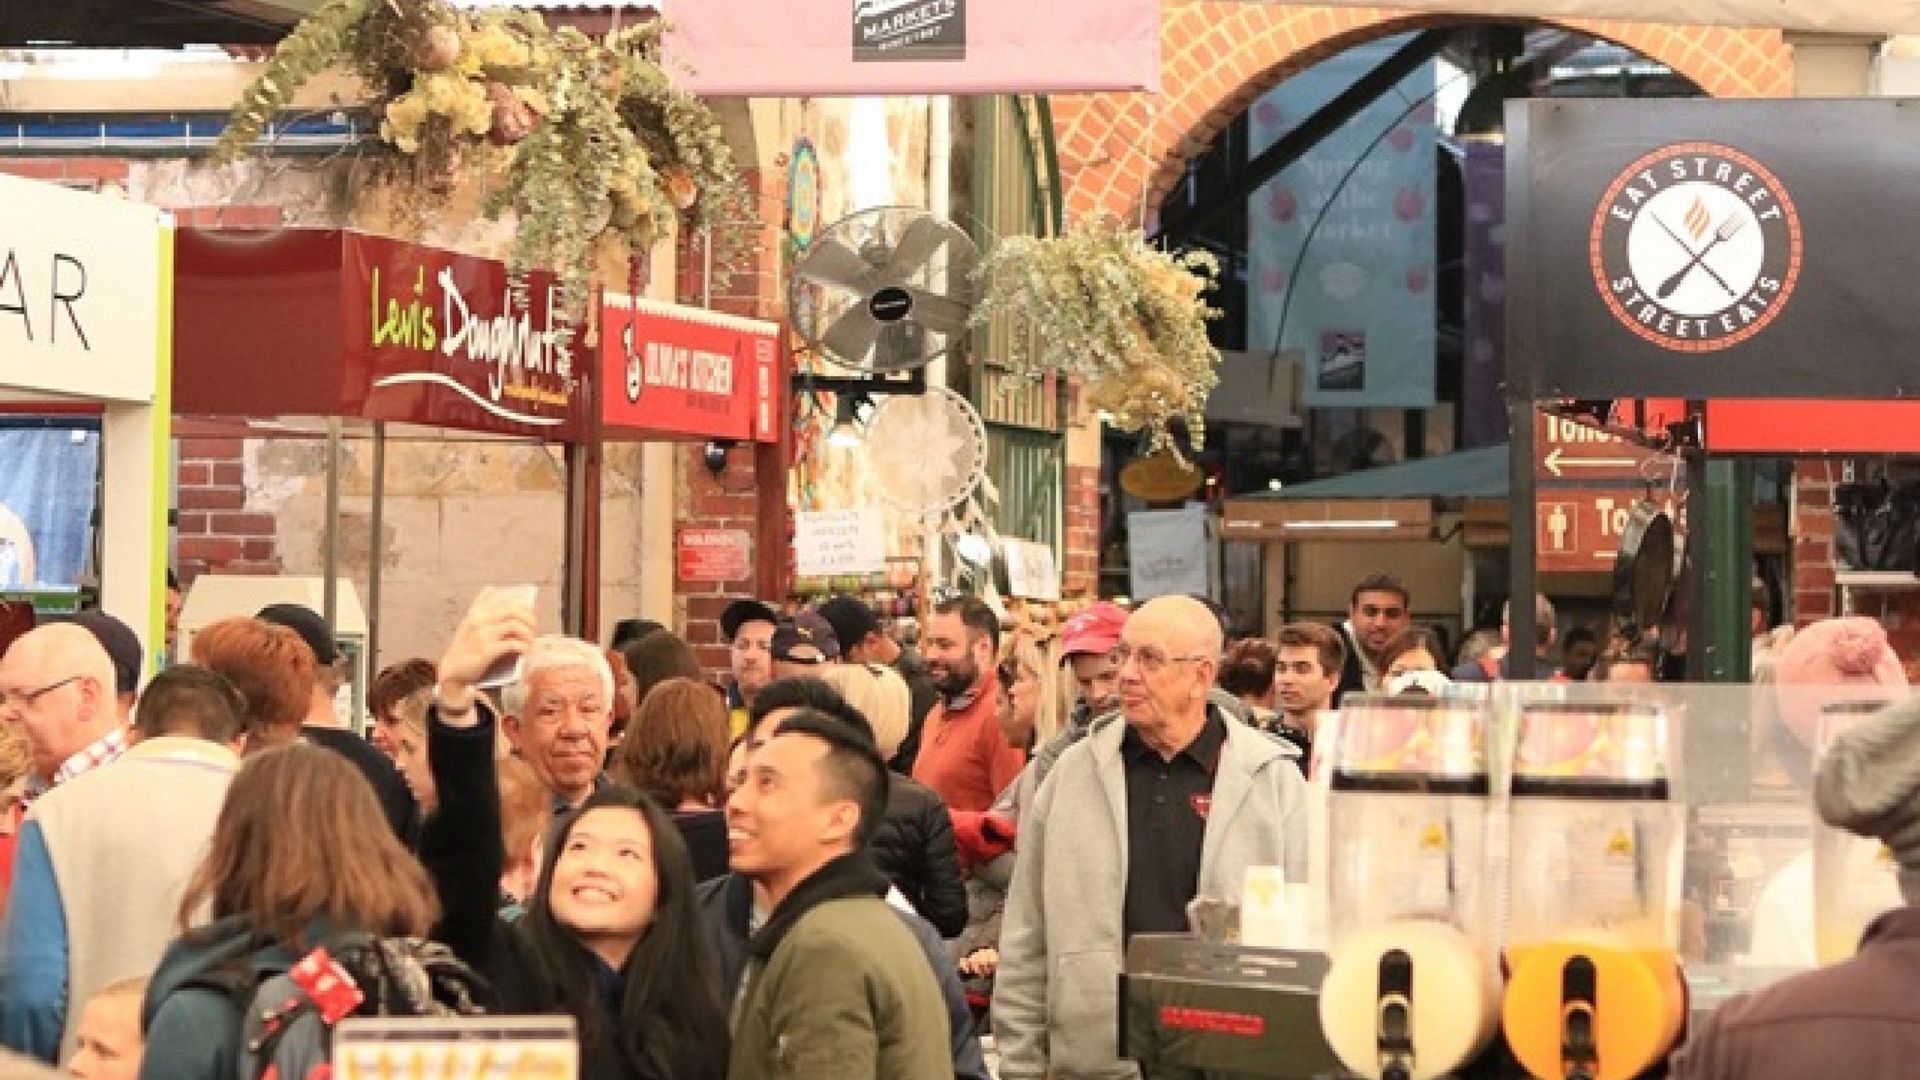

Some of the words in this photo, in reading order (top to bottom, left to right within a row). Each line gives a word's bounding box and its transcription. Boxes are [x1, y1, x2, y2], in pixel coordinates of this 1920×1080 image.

[863, 0, 956, 39] MARKETS
[1611, 169, 1658, 222] EAT
[1670, 157, 1783, 220] STREET
[1612, 276, 1708, 338] STREET
[1719, 276, 1781, 333] EATS
